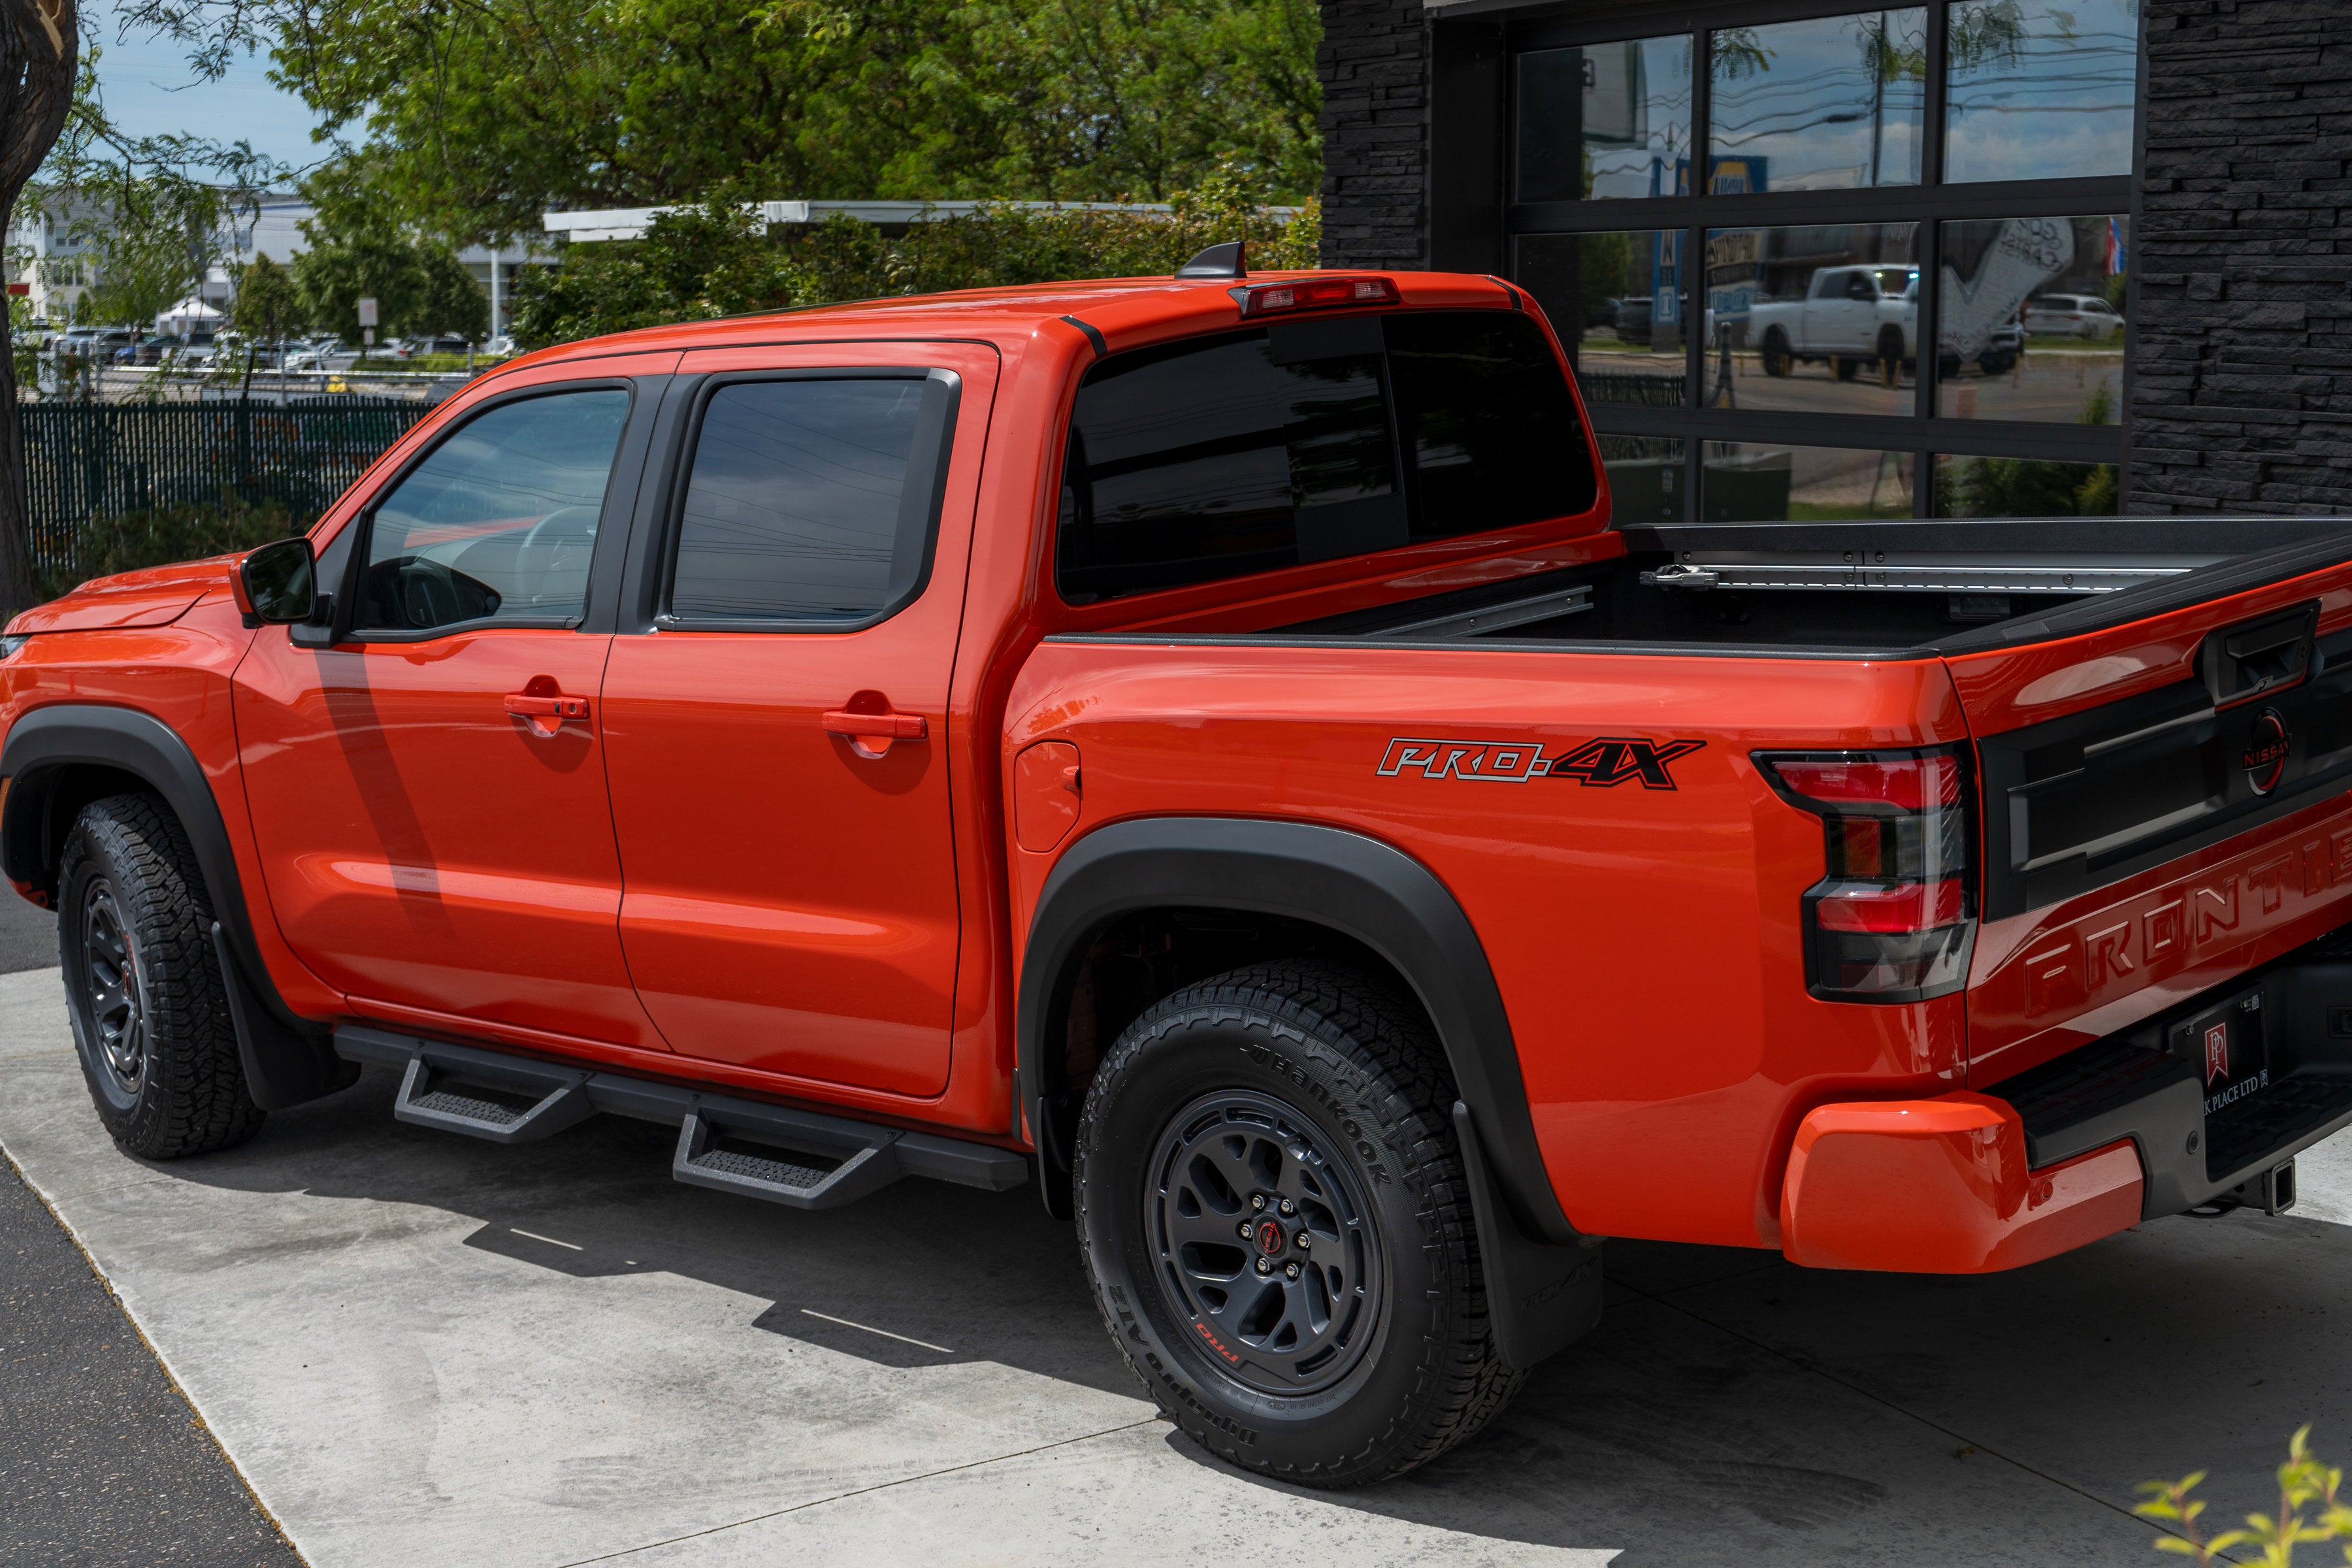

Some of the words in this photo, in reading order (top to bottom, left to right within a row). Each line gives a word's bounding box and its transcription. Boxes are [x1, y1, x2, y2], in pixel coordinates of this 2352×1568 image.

[1375, 736, 1707, 791] PRO-4X
[2244, 741, 2289, 767] NISSAN
[2212, 1086, 2239, 1111] PLACE
[2240, 1077, 2258, 1096] LTD
[1271, 1053, 1392, 1188] Hankook
[1264, 1222, 1276, 1254] NISSAN
[1196, 1323, 1239, 1362] PRO
[1145, 1352, 1259, 1447] Dynapro
